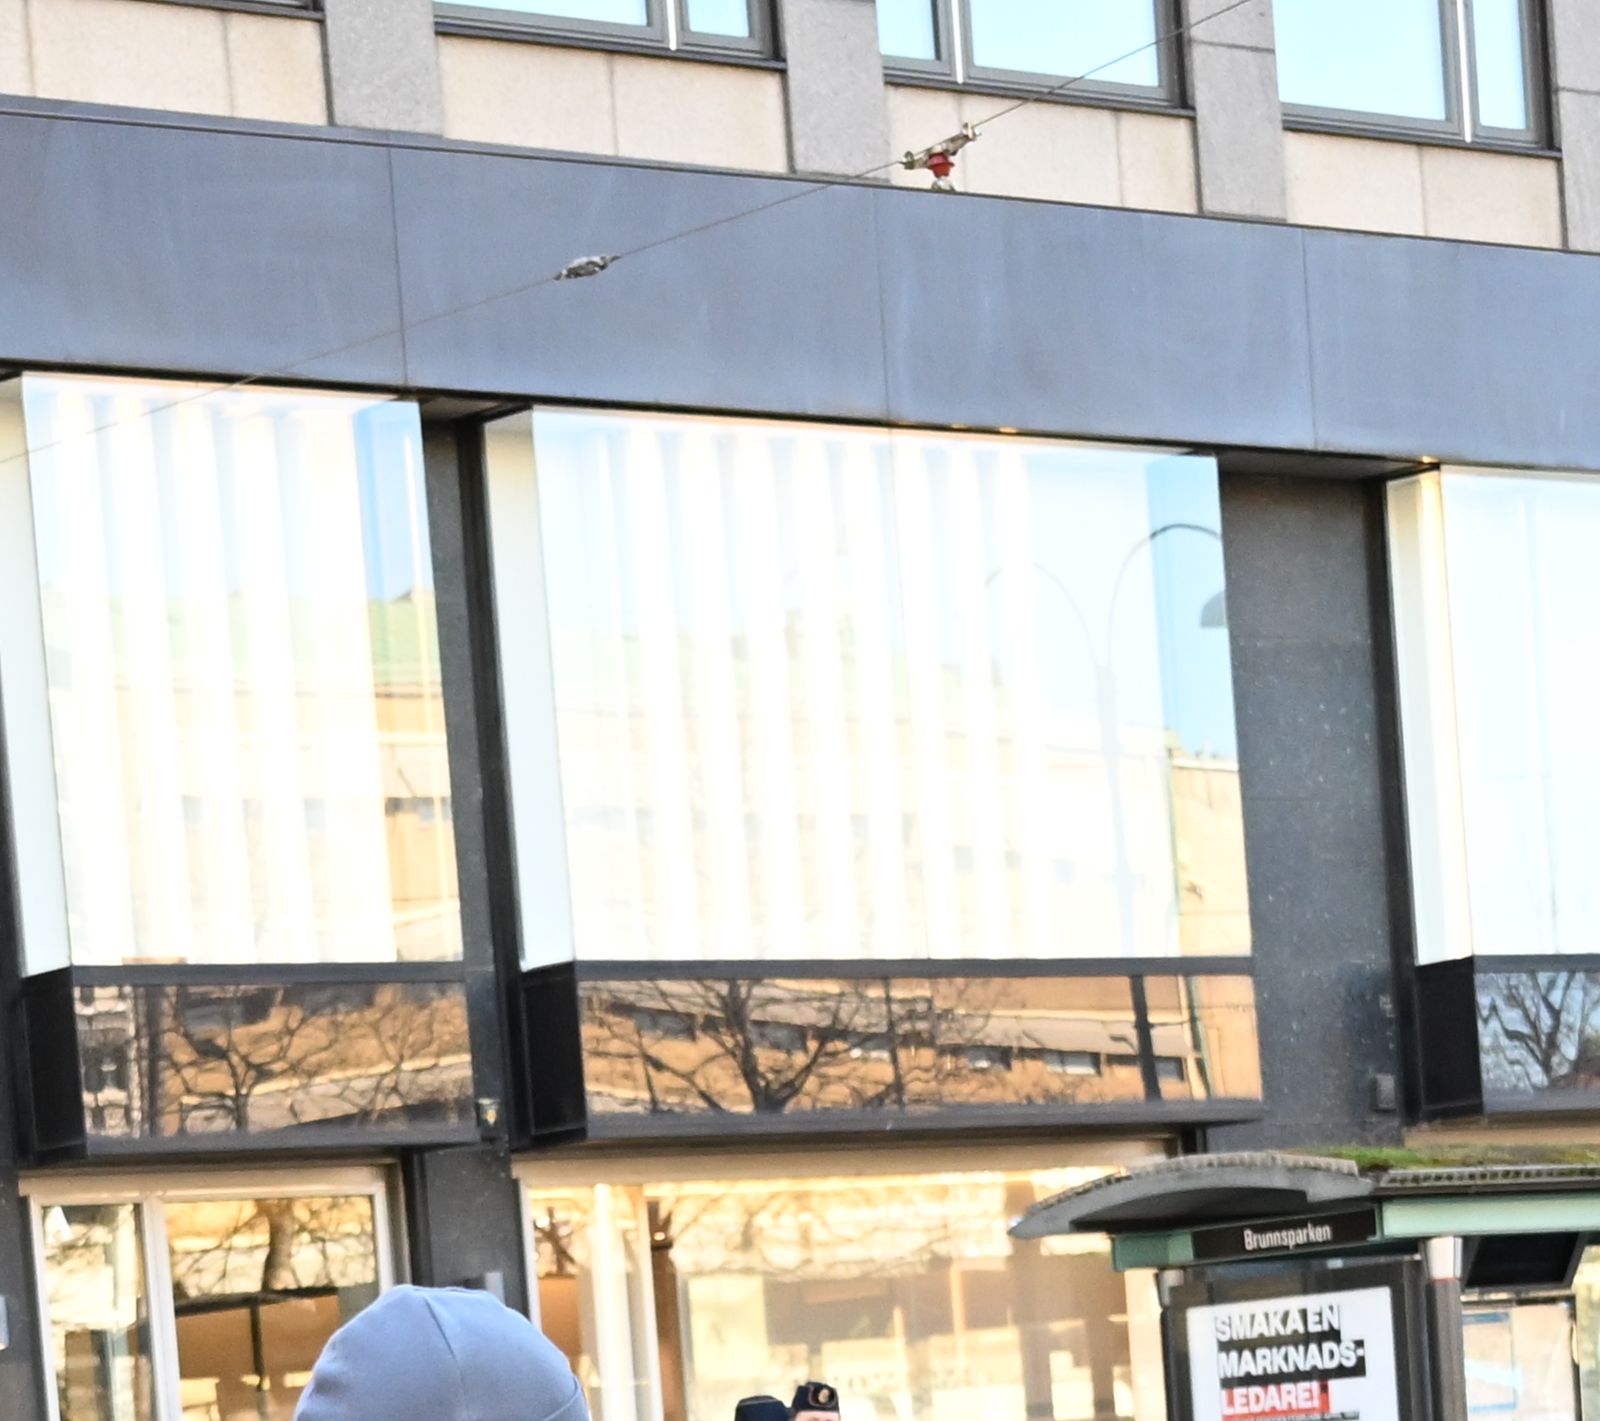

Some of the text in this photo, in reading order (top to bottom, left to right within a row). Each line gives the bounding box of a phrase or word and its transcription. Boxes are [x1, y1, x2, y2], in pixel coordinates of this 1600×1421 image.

[1243, 1221, 1332, 1251] Brunnsparken
[1215, 1304, 1340, 1341] SMAKA EN
[1218, 1341, 1365, 1379] MARKNADS-
